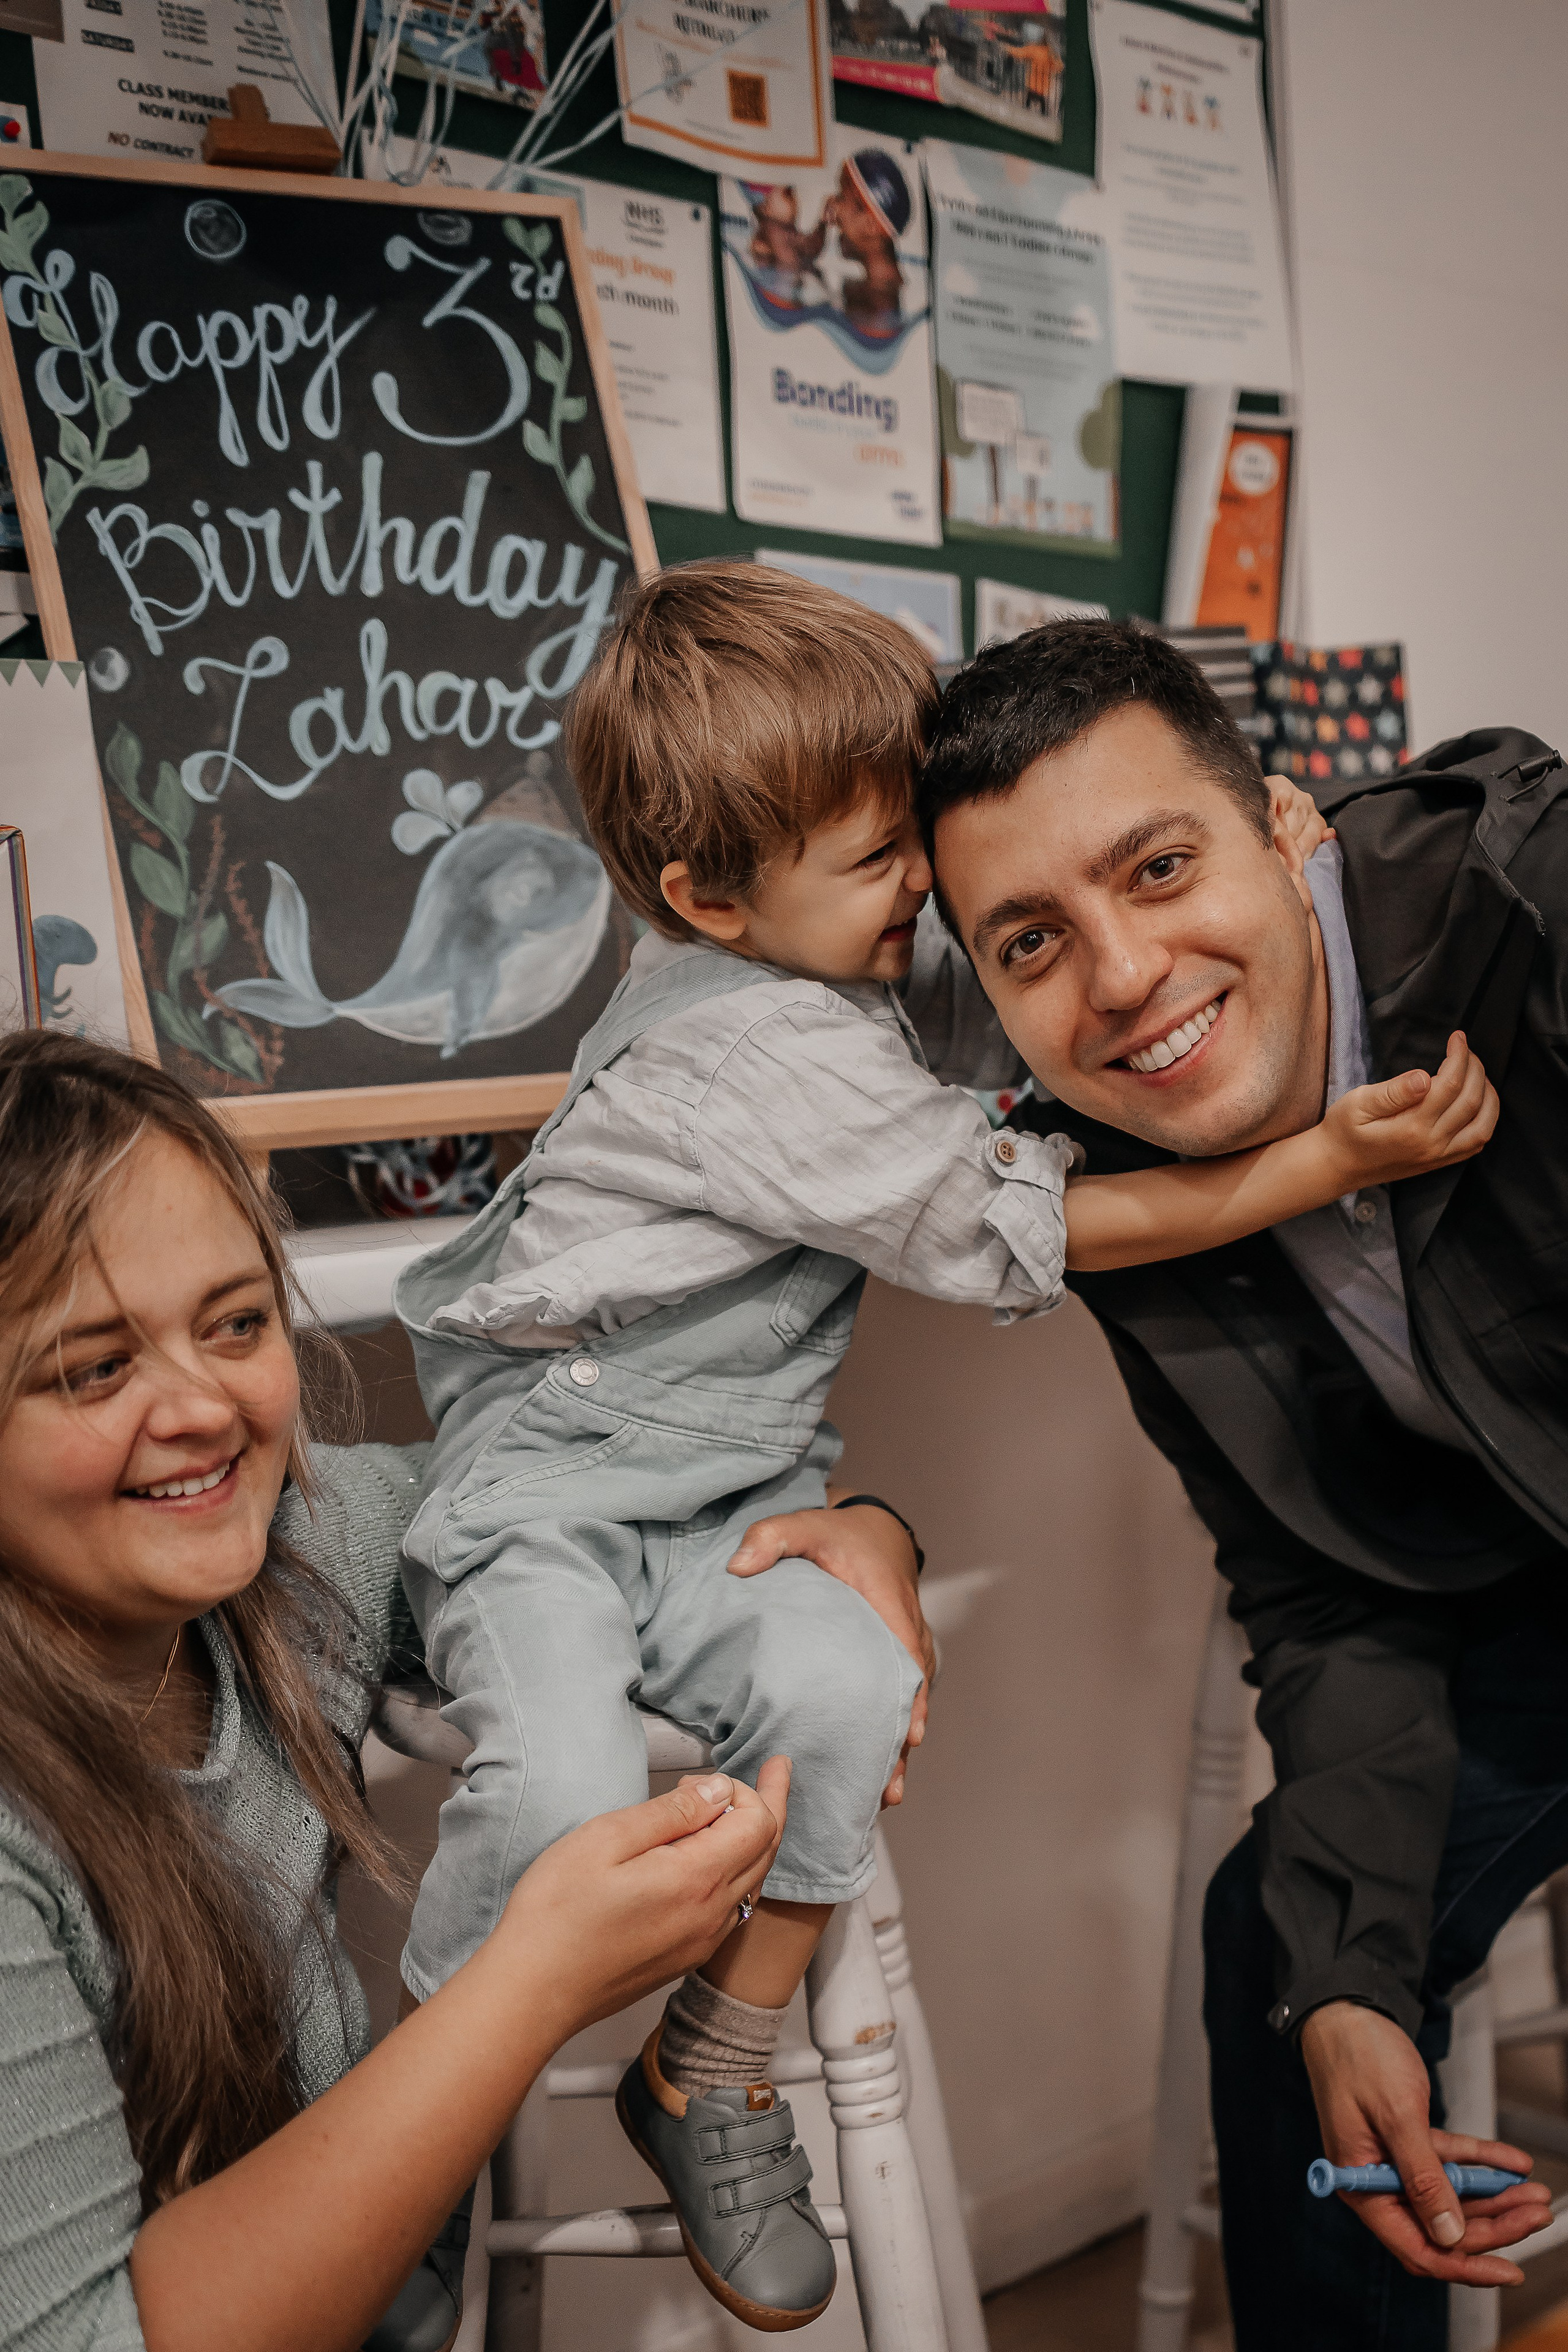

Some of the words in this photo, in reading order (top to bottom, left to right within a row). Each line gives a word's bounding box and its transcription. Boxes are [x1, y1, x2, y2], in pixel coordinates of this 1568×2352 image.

[117, 78, 164, 99] CLASS
[167, 87, 231, 112] MEMBER
[138, 101, 175, 120] NOW
[178, 108, 214, 126] AVA
[107, 130, 130, 146] NO
[133, 138, 195, 159] CONTRACT
[2, 250, 375, 467] Happy
[772, 366, 899, 434] Bonding
[86, 452, 618, 698] Birthday
